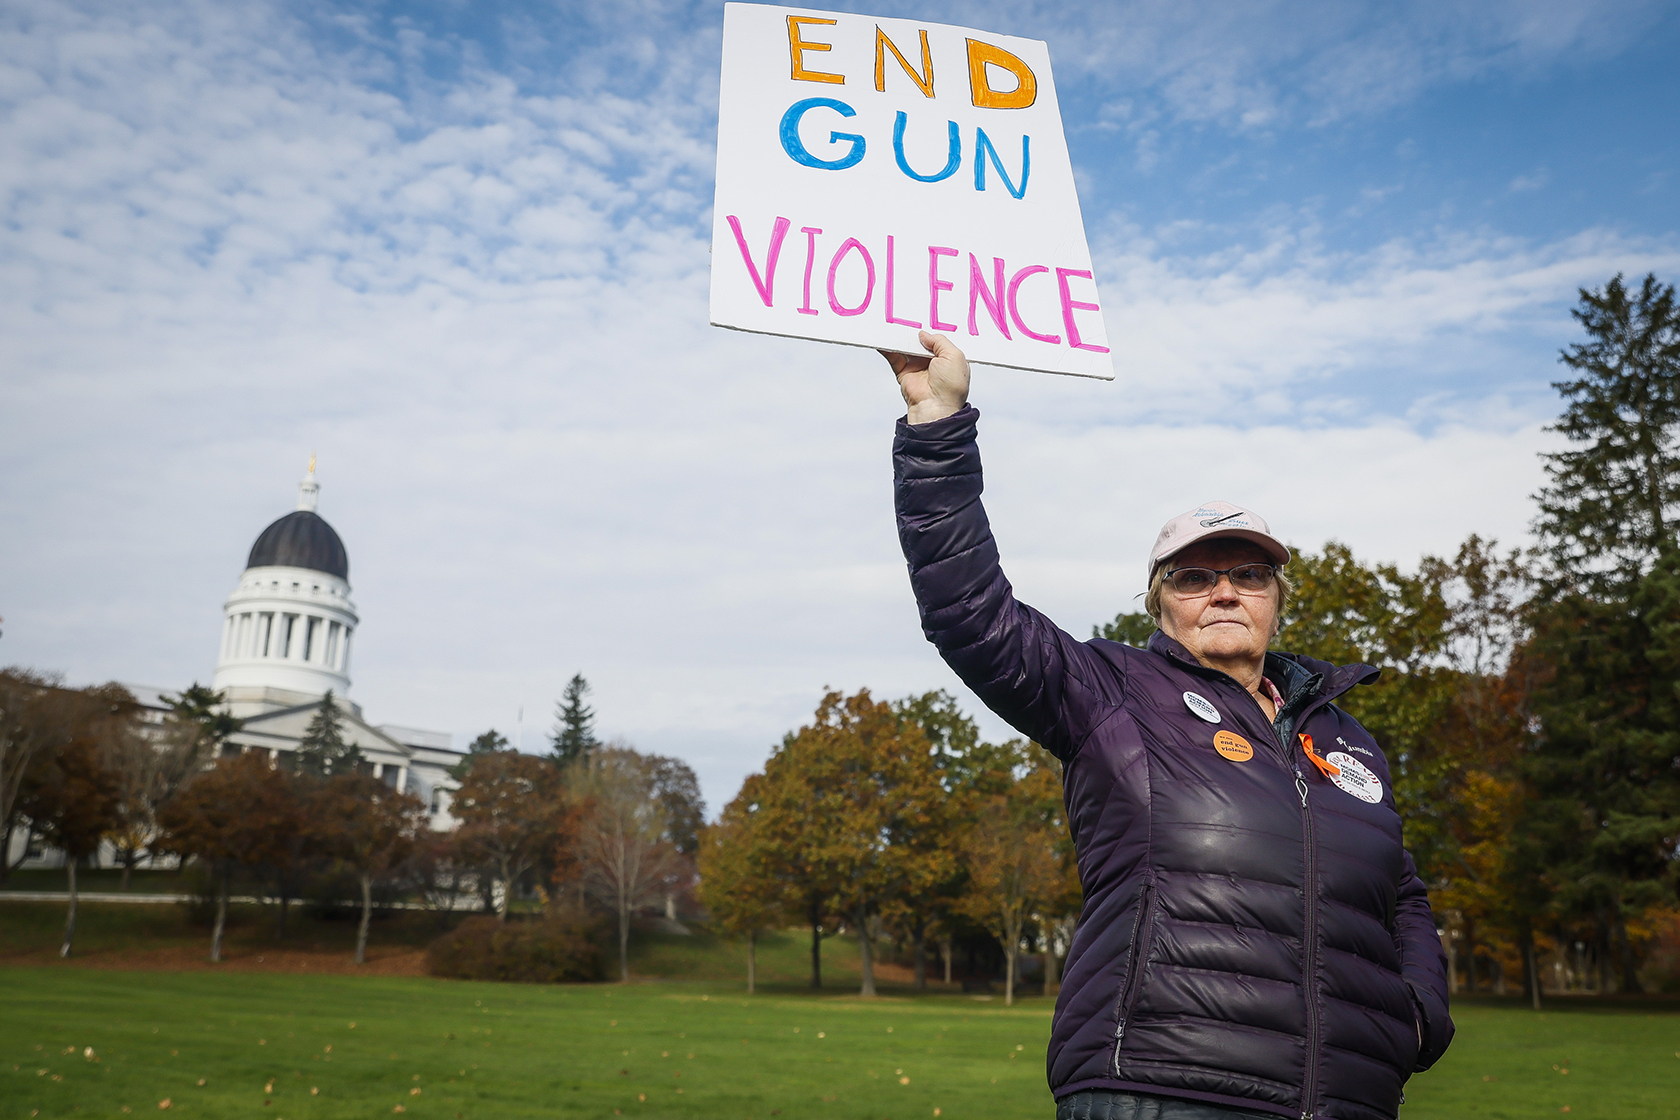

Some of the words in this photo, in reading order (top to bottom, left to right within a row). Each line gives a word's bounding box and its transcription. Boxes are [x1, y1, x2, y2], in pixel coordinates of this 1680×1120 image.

[786, 14, 1038, 110] END
[779, 97, 1031, 200] GUN
[726, 215, 1111, 354] VIOLENCE
[1221, 746, 1250, 755] violence
[1341, 768, 1368, 784] DEMAND
[1341, 774, 1365, 788] ACTION
